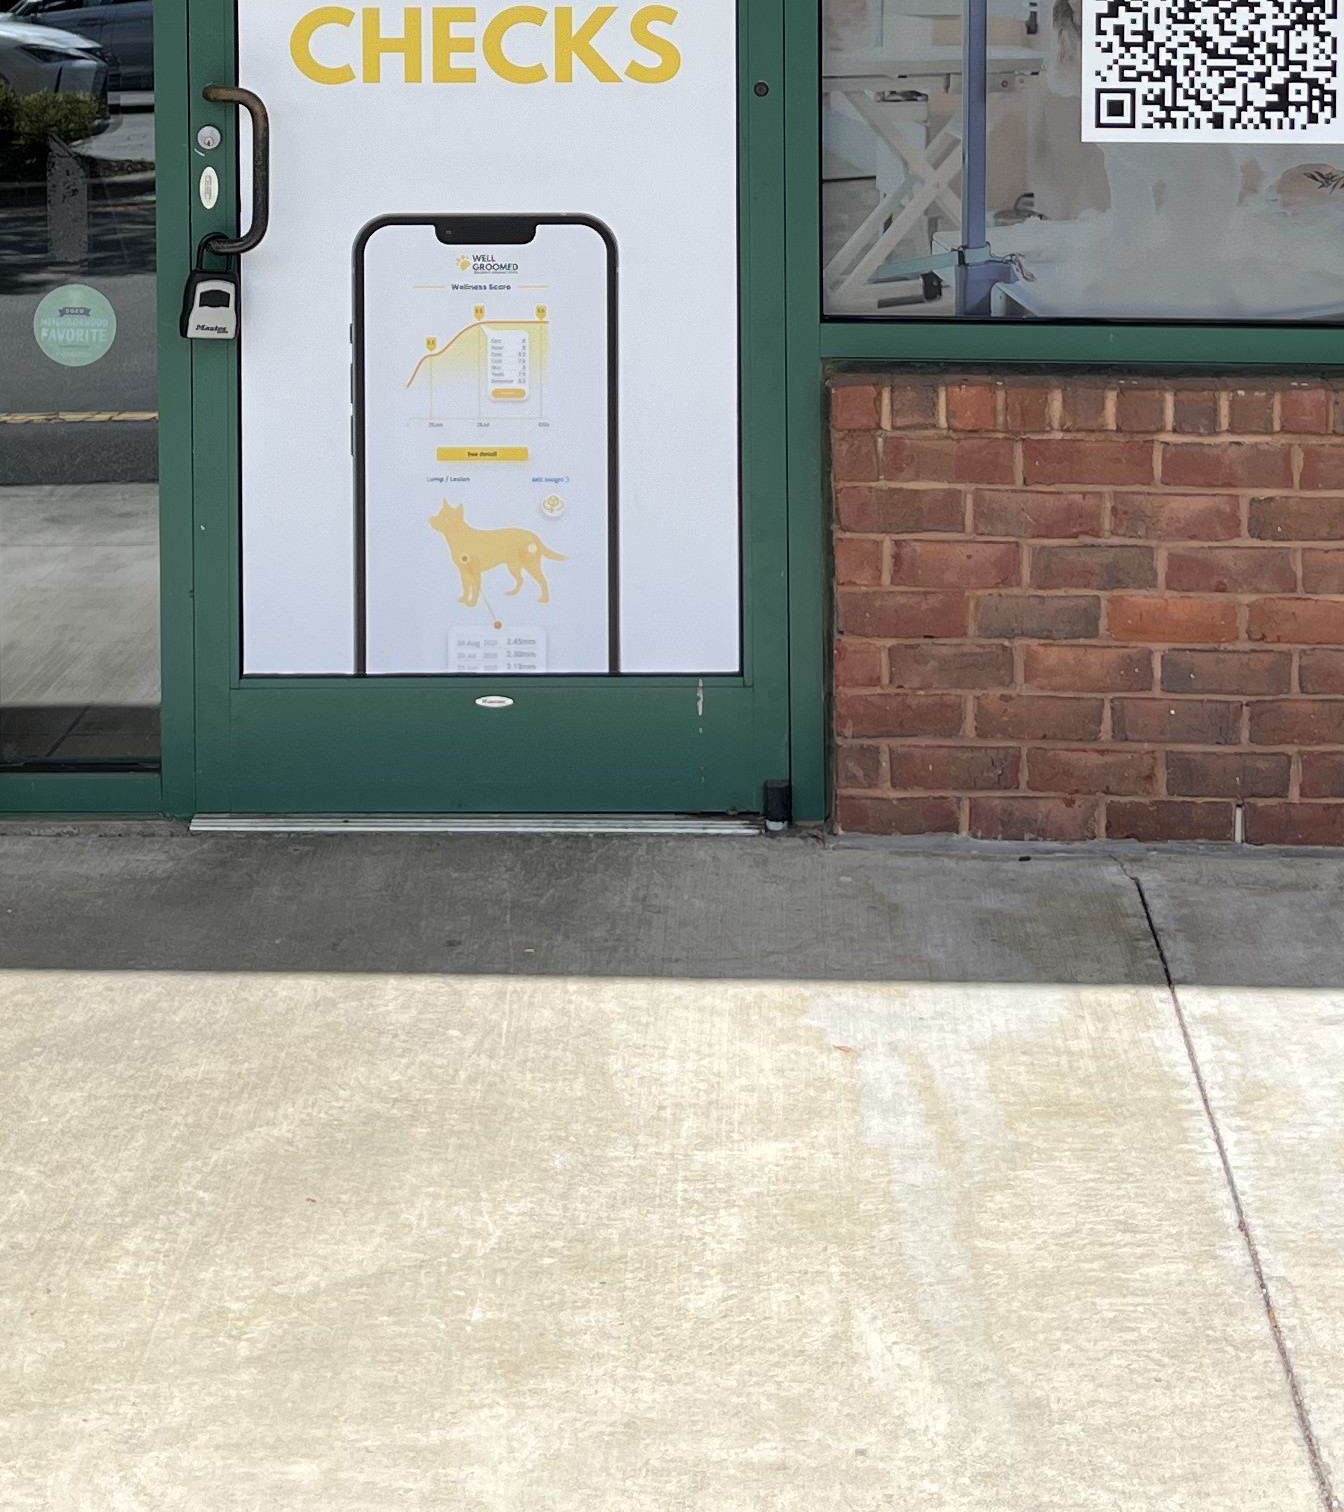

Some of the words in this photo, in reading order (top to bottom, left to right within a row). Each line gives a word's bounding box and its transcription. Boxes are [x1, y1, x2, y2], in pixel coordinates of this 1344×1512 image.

[290, 5, 681, 85] CHECKS
[472, 254, 496, 262] WELL
[473, 262, 518, 271] GROOMED
[451, 283, 487, 291] Wellness
[489, 283, 511, 291] Score
[41, 328, 108, 343] FAVORITE
